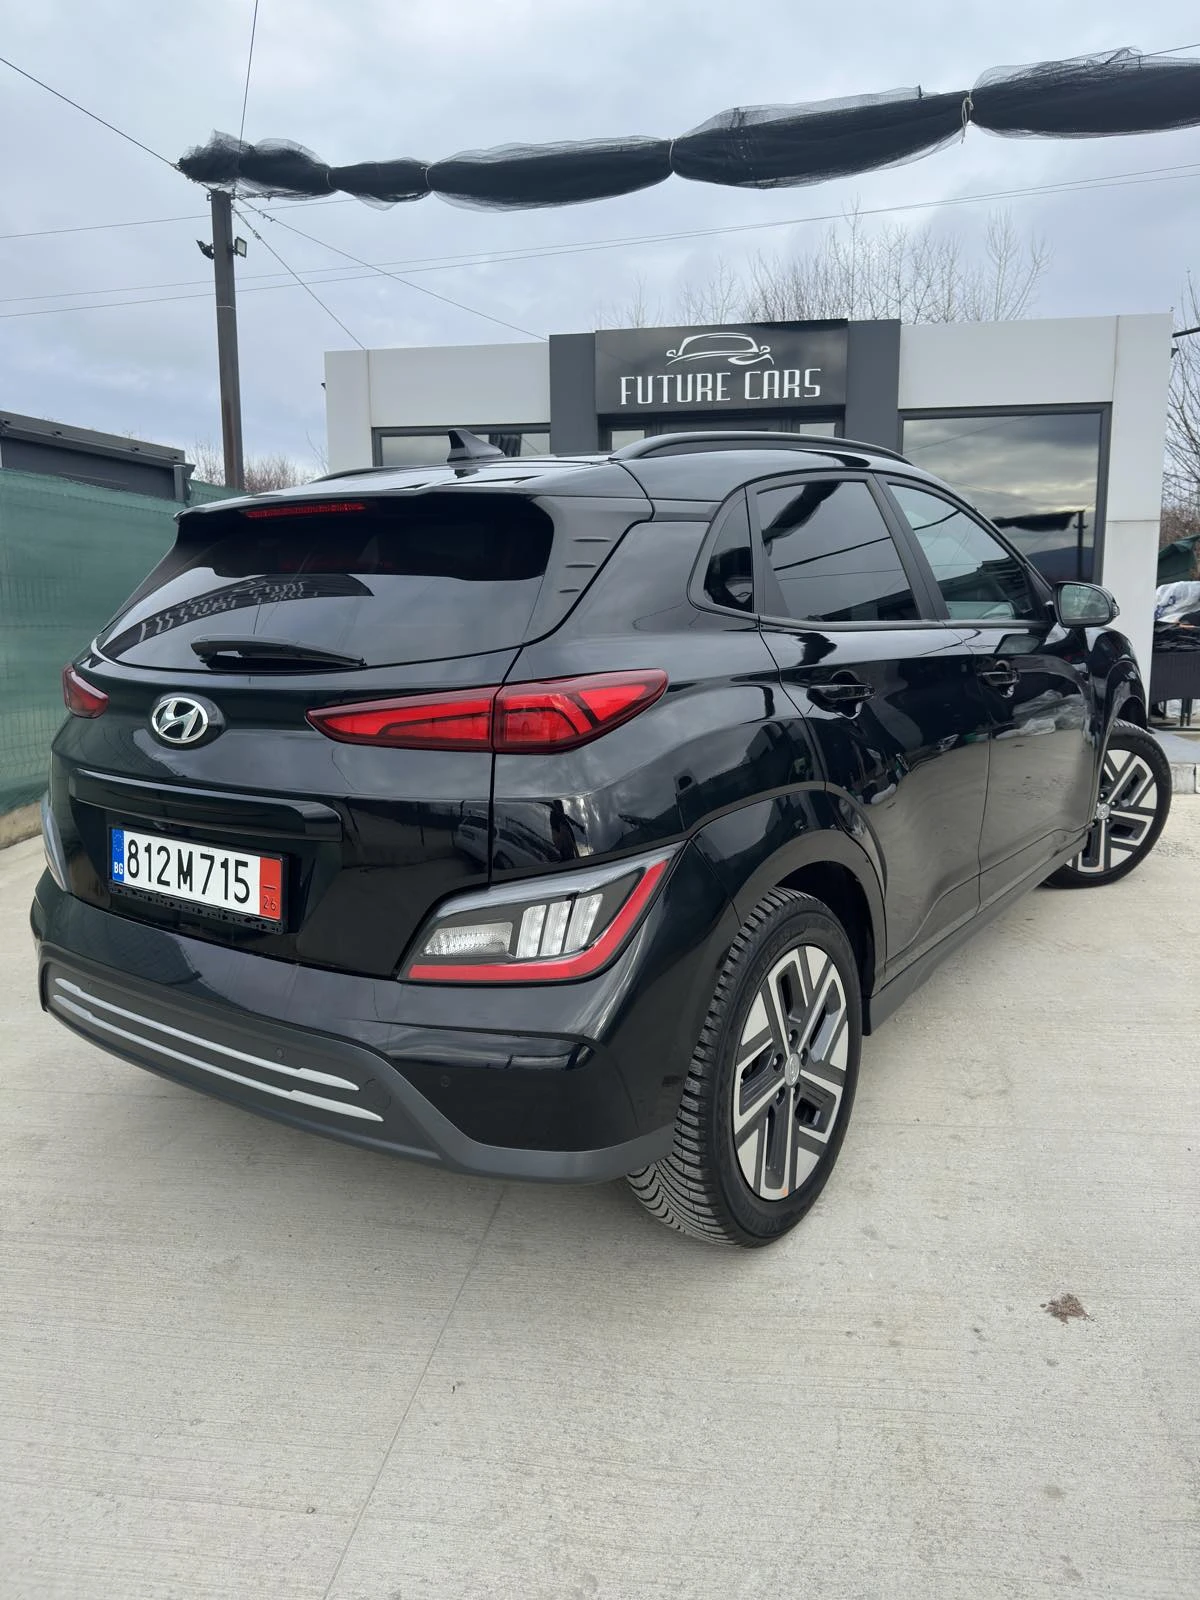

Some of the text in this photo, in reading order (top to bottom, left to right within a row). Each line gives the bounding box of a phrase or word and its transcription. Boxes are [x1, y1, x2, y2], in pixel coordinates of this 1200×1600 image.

[620, 368, 822, 405] FUTURE CARS
[114, 862, 124, 874] BG
[263, 895, 277, 912] 26
